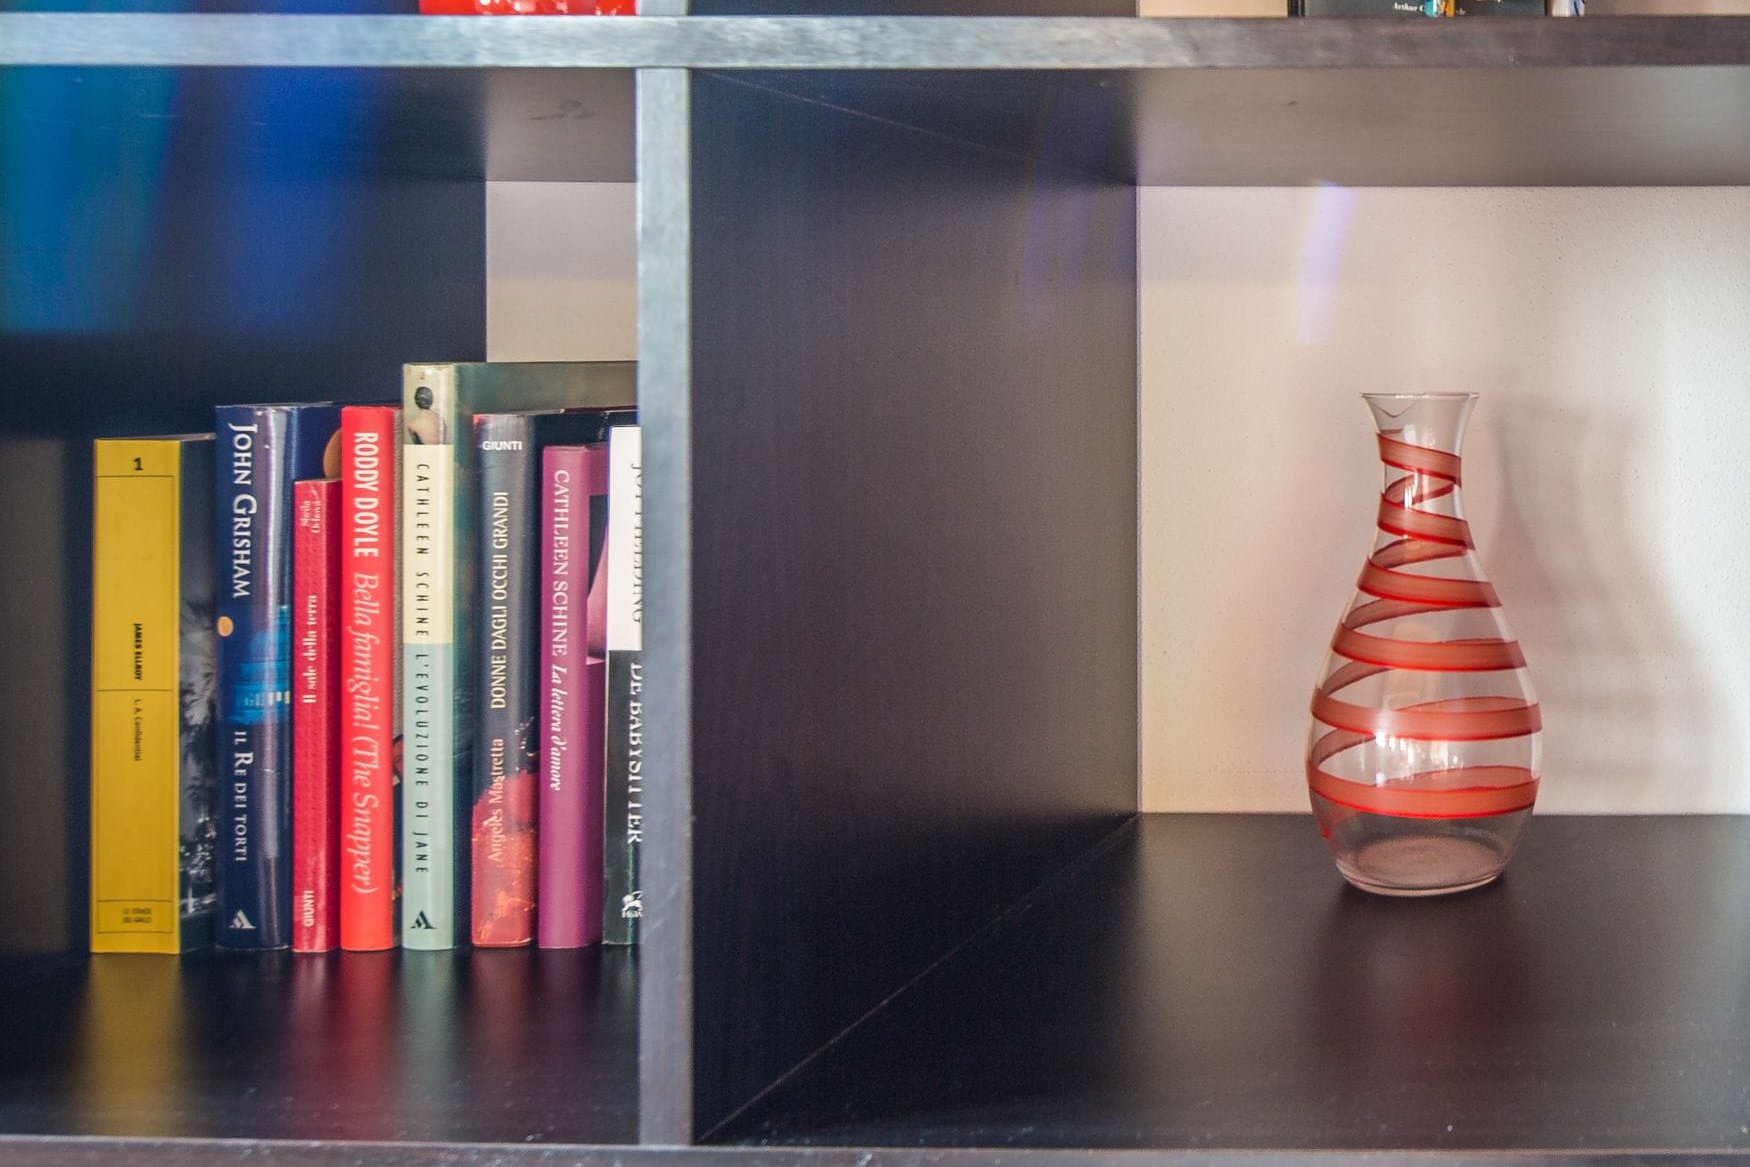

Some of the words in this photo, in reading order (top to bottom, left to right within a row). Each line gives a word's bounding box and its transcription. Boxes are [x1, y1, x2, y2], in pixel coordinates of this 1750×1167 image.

[133, 457, 143, 471] 1
[228, 422, 258, 485] JOHN
[354, 432, 379, 492] RODDY
[482, 440, 523, 451] GIUNTI
[354, 497, 379, 558] DOYLE
[416, 464, 430, 555] CATHLEEN
[493, 491, 509, 549] GRANDI
[552, 469, 570, 575] CATHLEEN
[232, 493, 258, 598] GRISHAM
[354, 573, 380, 626] Bella
[492, 554, 508, 601] OCCHI
[306, 595, 318, 625] terra
[416, 572, 430, 636] SCHINE
[491, 605, 507, 650] DAGLI
[552, 581, 568, 656] SCHINE
[133, 623, 142, 649] JAMES
[302, 630, 317, 662] della
[133, 651, 142, 681] ELLROY
[346, 625, 381, 731] famiglia!
[491, 655, 507, 709] DONNE
[550, 664, 567, 684] La
[415, 654, 429, 786] L'EVOLUZIONE
[550, 686, 567, 733] lettera
[234, 731, 247, 745] IL
[352, 735, 380, 789] (The
[550, 735, 567, 791] d'amore
[234, 751, 254, 776] RE
[489, 738, 506, 804] Mastretta
[234, 783, 247, 809] DEI
[415, 801, 429, 818] DI
[234, 814, 247, 861] TORTI
[347, 792, 380, 894] Snapper)
[413, 832, 429, 873] JANE
[304, 890, 316, 927] GIUNTI
